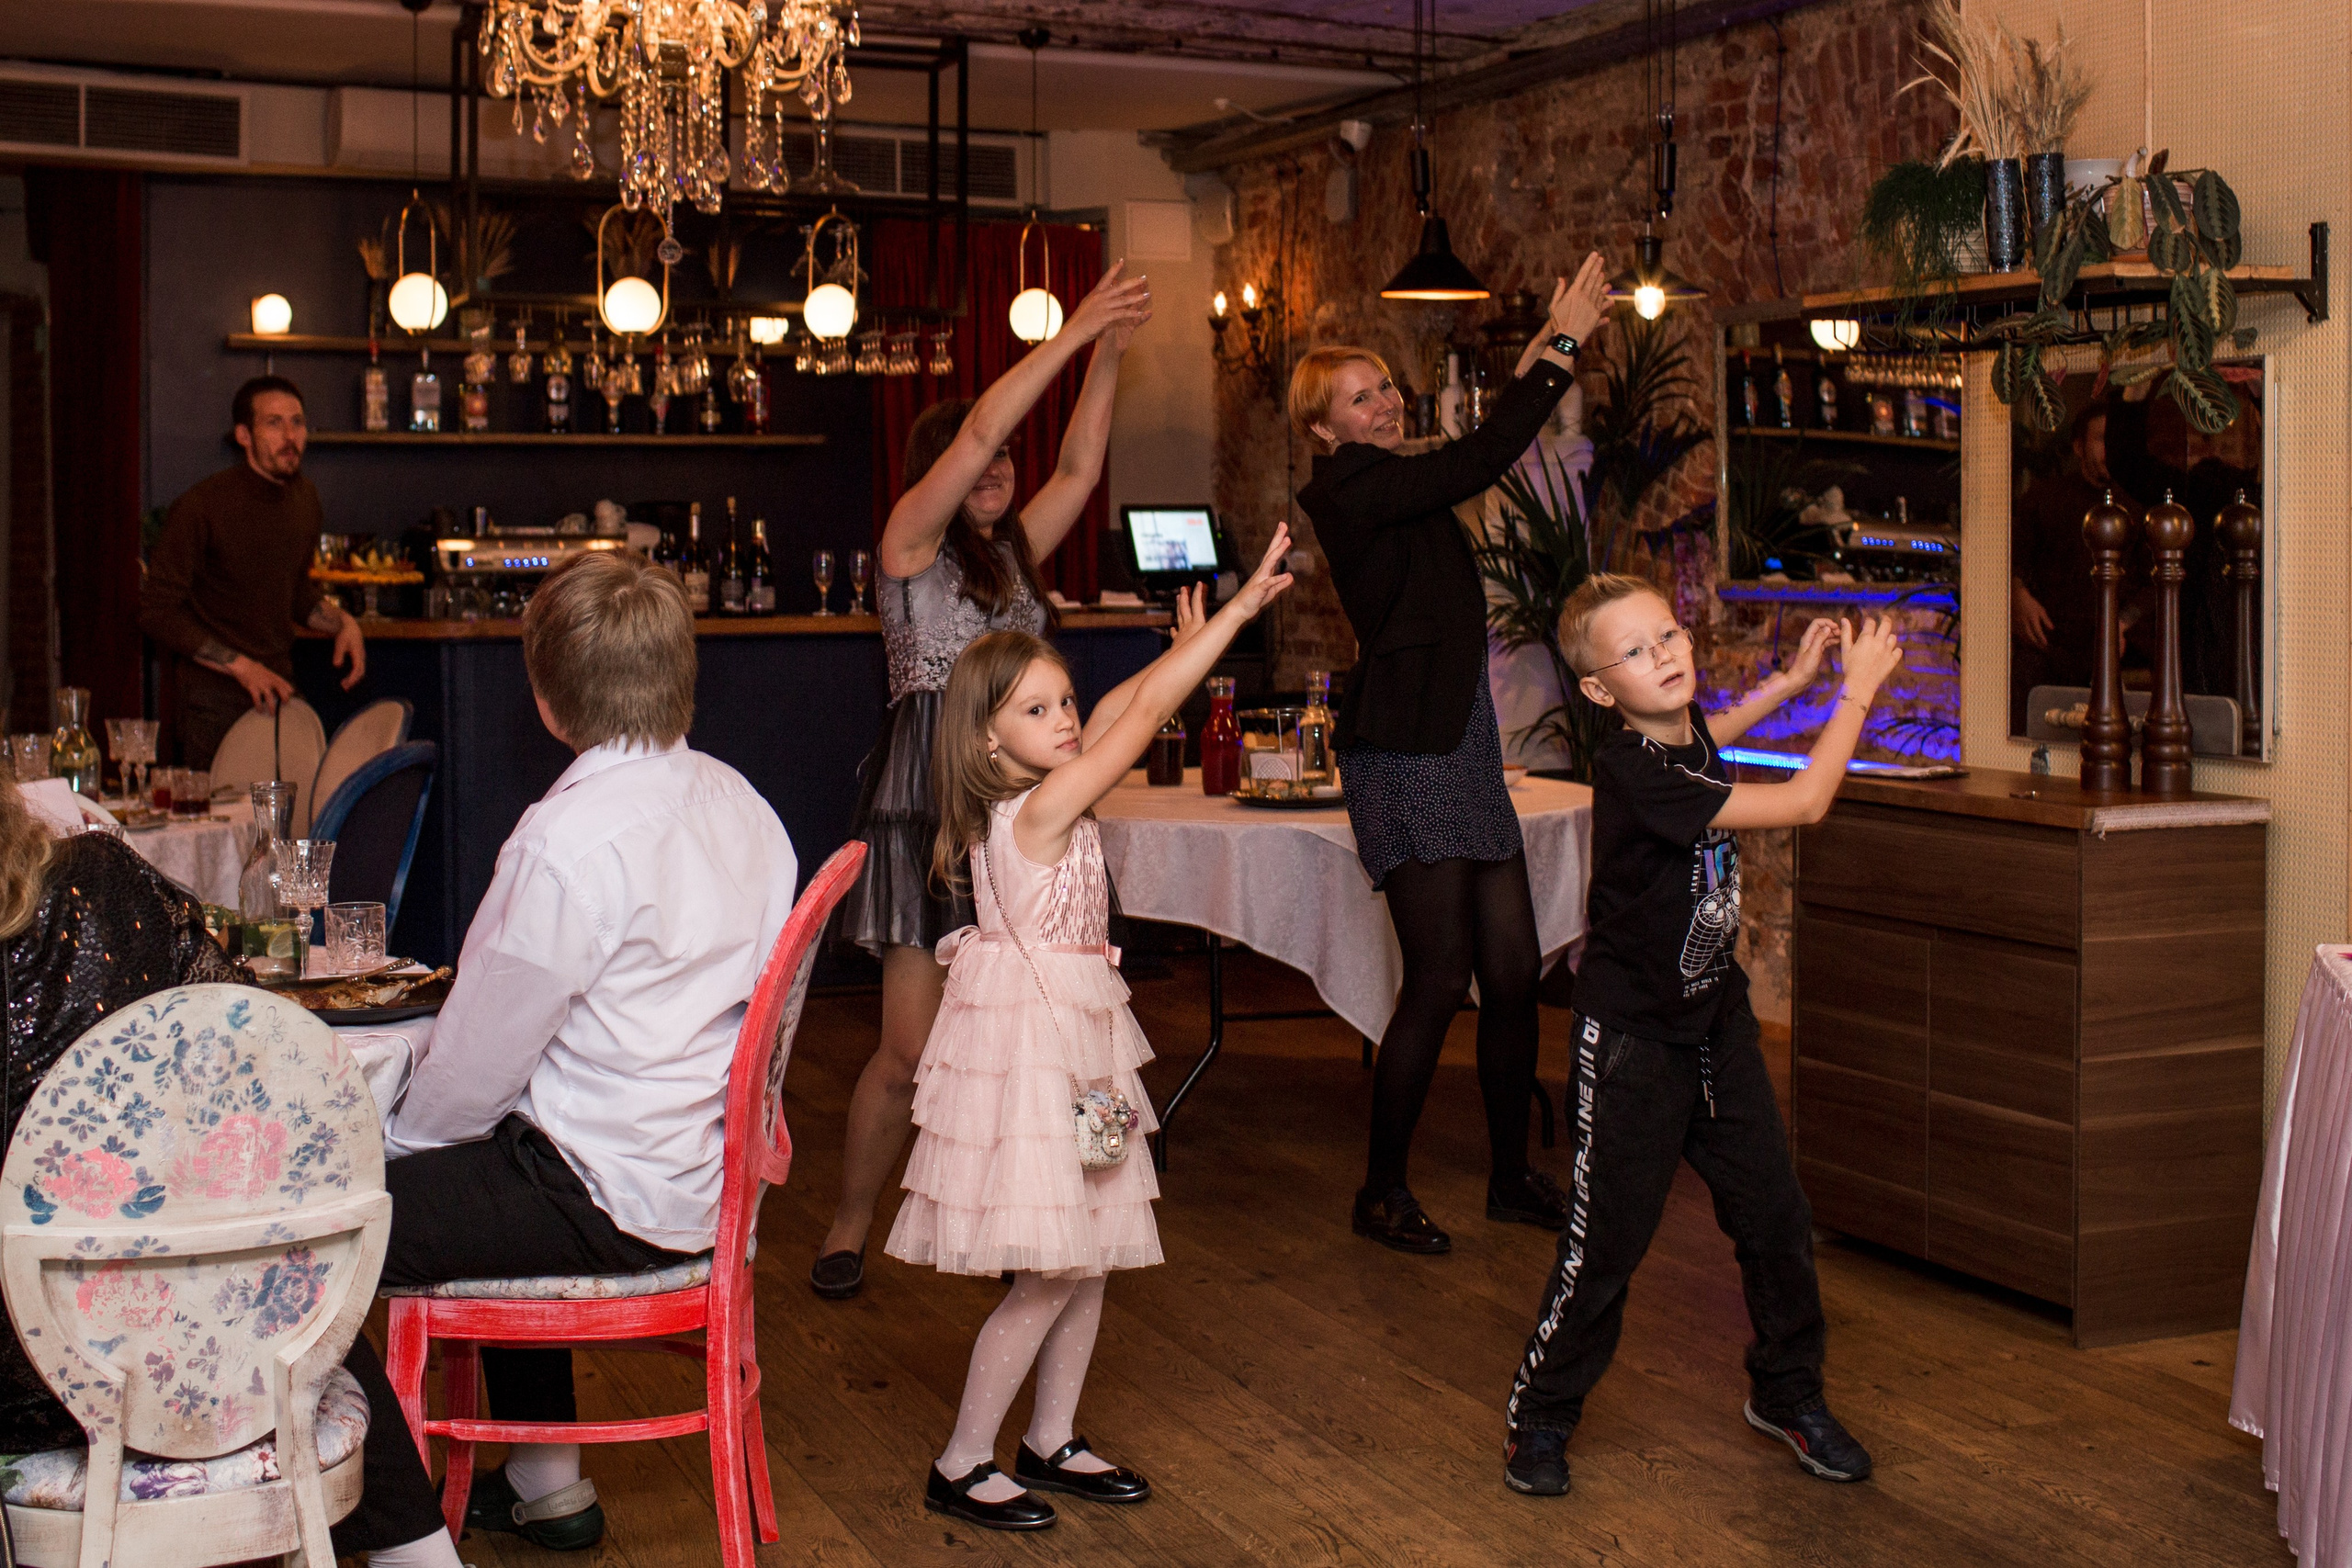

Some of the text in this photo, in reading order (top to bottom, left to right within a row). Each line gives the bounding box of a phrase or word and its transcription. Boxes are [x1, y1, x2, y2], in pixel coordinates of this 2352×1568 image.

[1690, 843, 1701, 892] LEVEL UP
[1538, 1237, 1584, 1342] OFF-LINE
[1573, 1080, 1594, 1202] OFF-LINE
